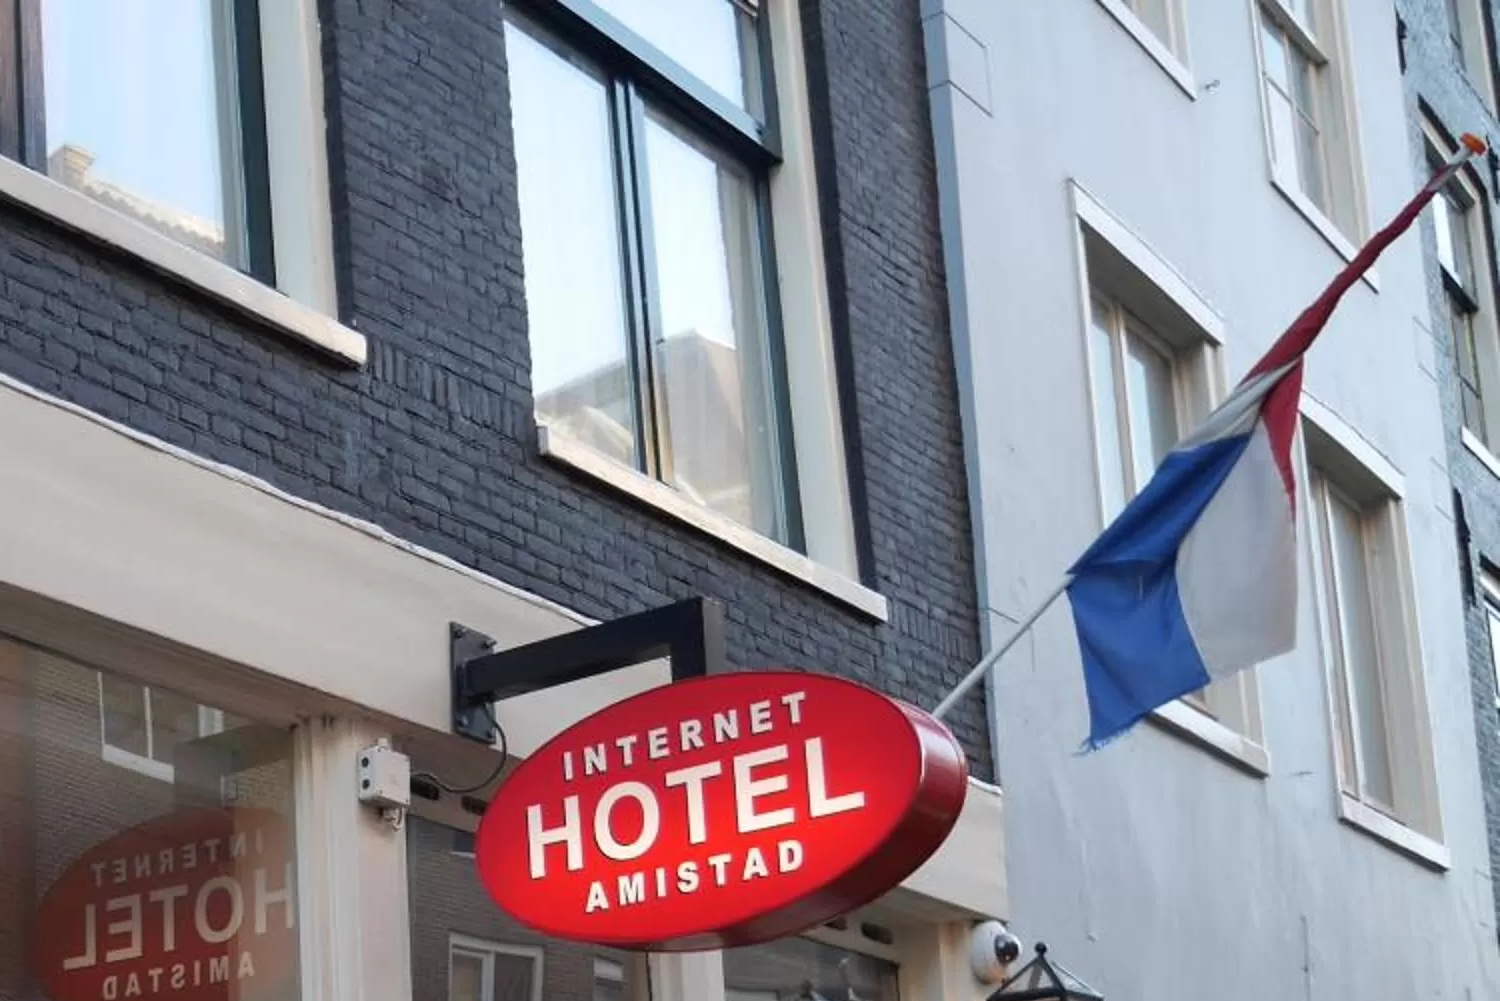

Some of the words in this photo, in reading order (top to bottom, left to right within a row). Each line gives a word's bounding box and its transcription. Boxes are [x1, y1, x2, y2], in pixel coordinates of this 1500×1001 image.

[562, 690, 808, 782] INTERNET
[525, 736, 867, 880] HOTEL
[585, 838, 806, 914] AMISTAD
